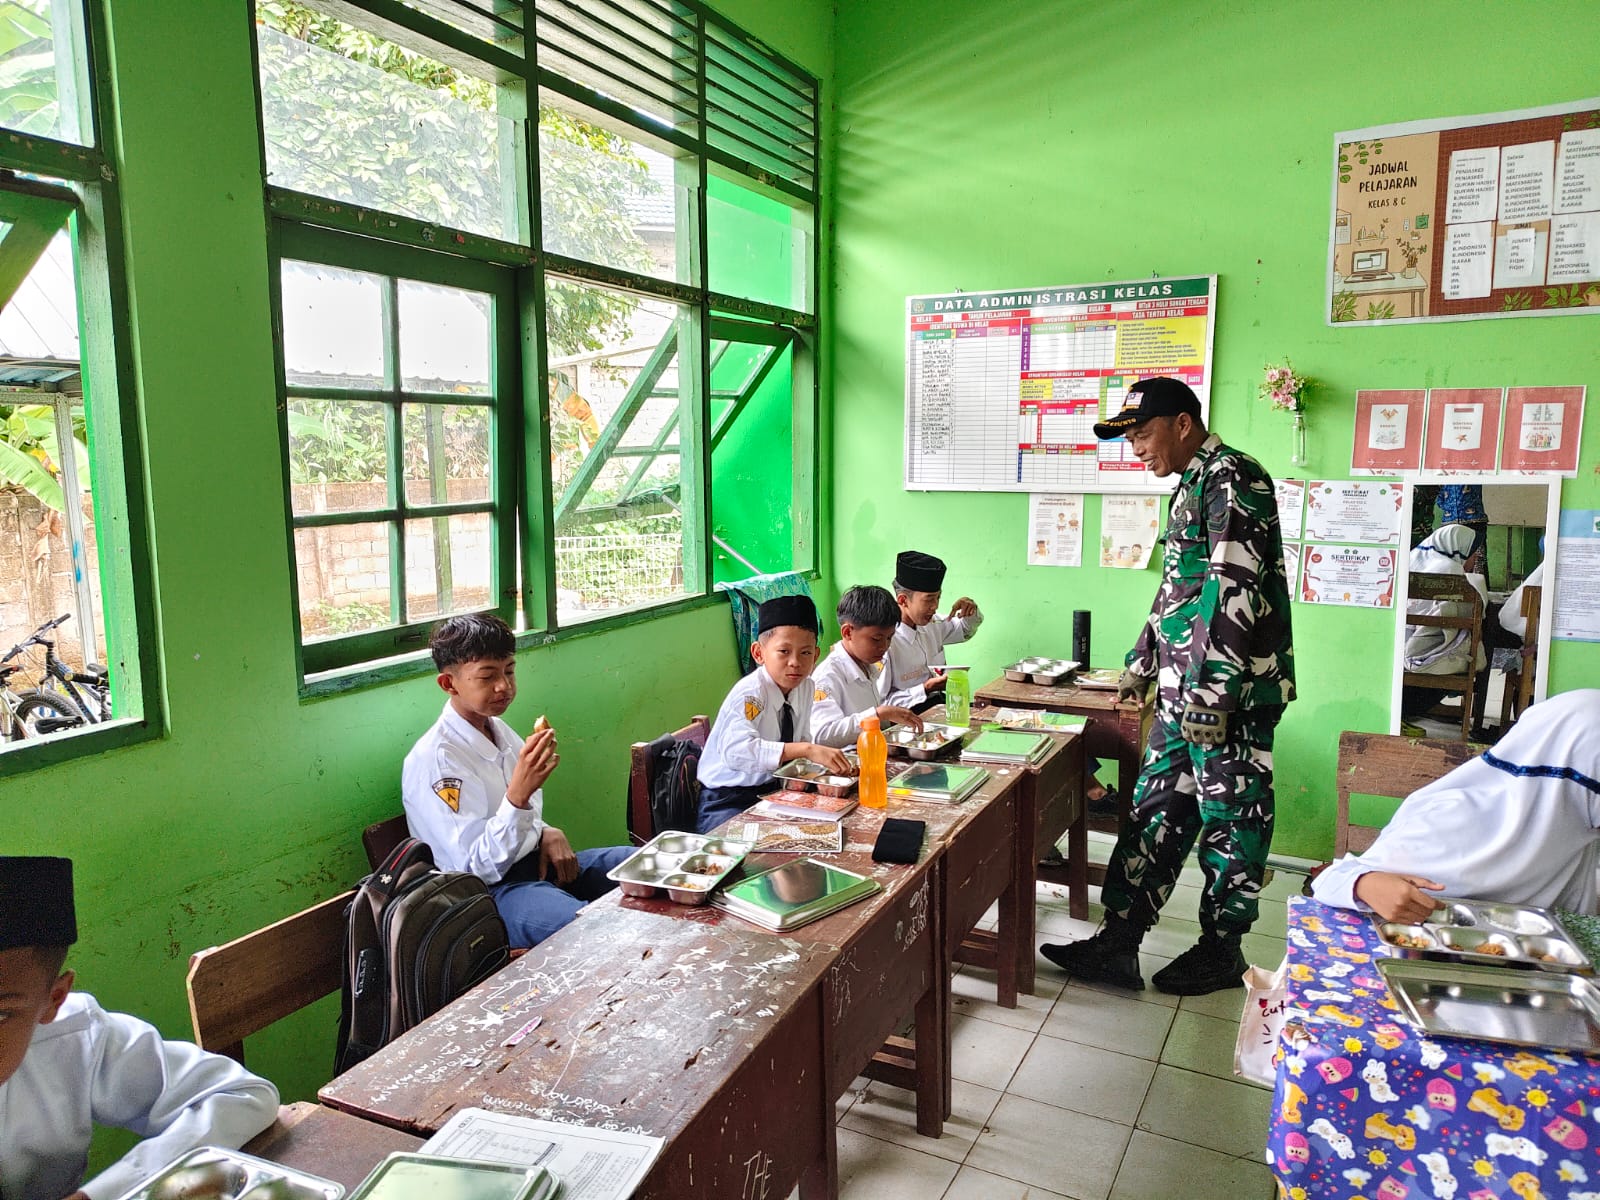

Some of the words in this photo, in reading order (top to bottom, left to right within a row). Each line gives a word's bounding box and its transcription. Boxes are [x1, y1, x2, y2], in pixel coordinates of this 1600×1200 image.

[1369, 161, 1409, 176] JADWAL
[1359, 176, 1418, 193] PELAJARAN
[1368, 199, 1390, 209] KELAS
[1400, 197, 1407, 206] C
[934, 299, 974, 311] DATA
[1114, 284, 1173, 299] KELAS
[1132, 311, 1146, 320] TATA
[1146, 310, 1167, 319] TERTIB
[1167, 308, 1185, 317] KELAS
[1331, 554, 1370, 562] SERTIFIKAT
